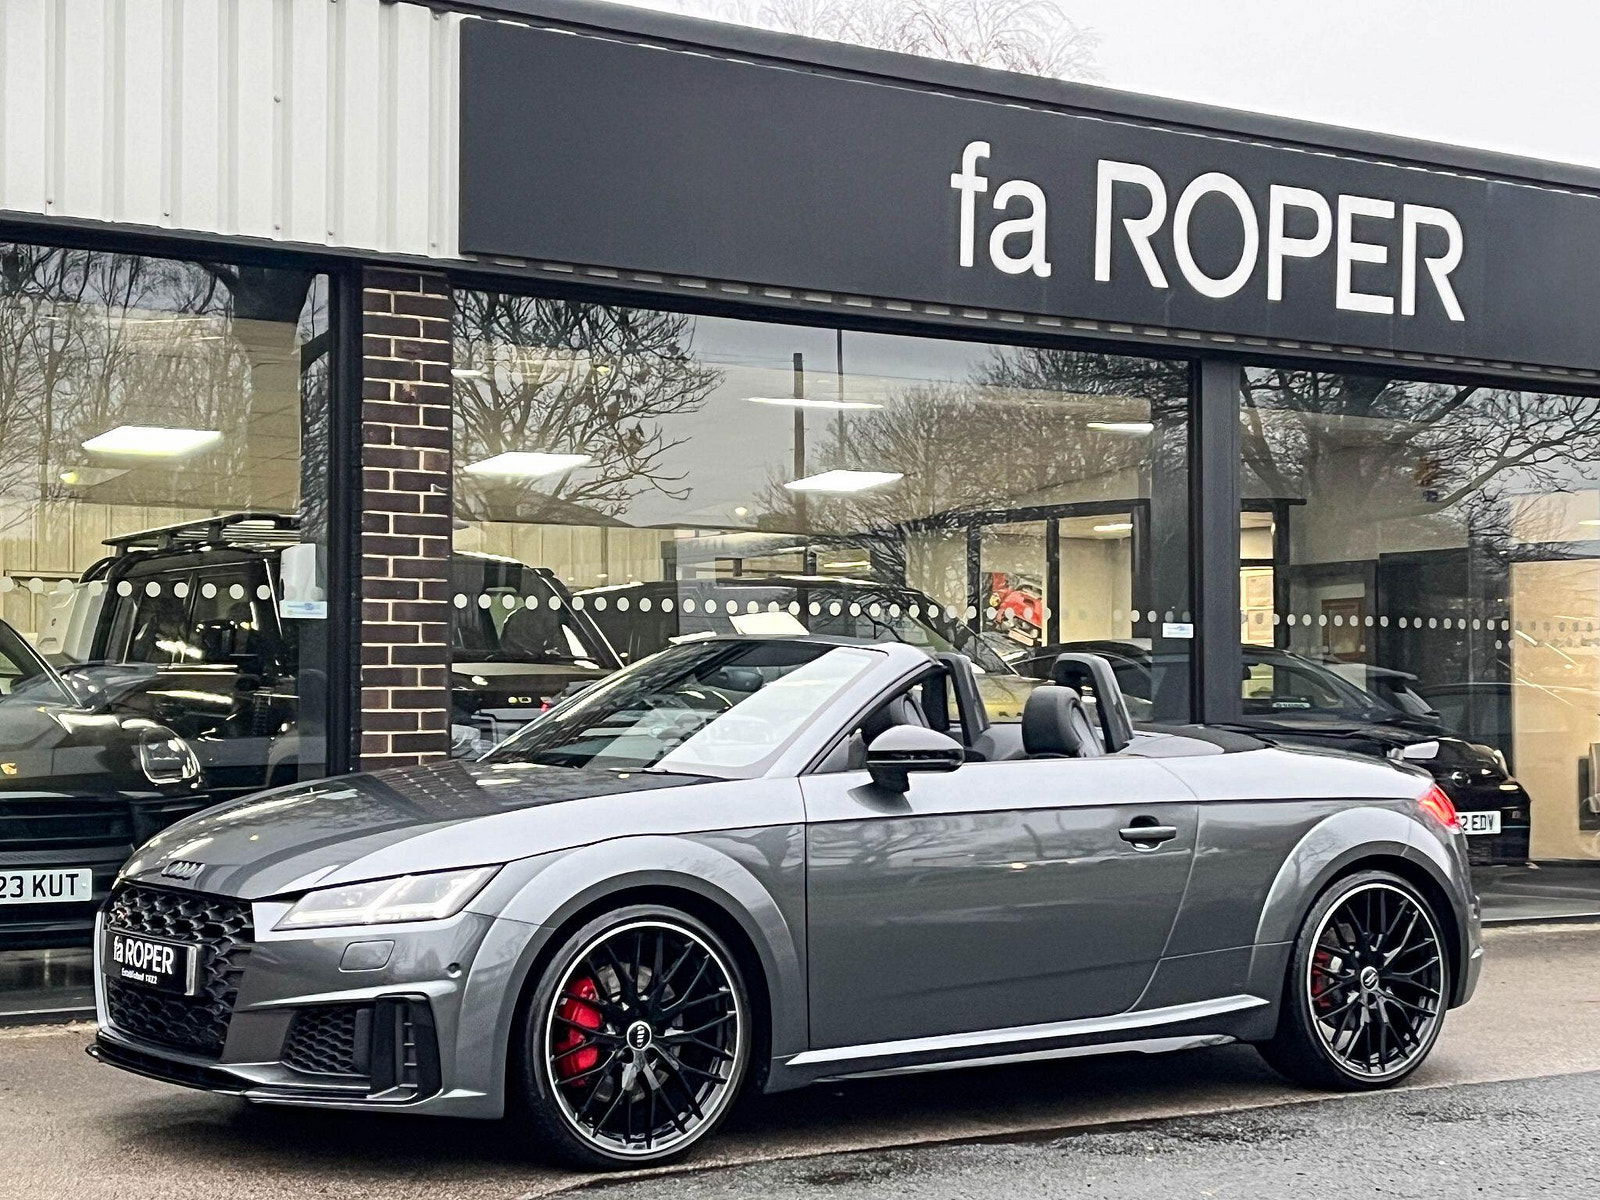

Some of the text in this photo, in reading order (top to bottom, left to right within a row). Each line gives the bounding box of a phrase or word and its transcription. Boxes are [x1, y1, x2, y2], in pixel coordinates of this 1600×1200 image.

[951, 141, 1466, 322] fa ROPER
[32, 873, 79, 898] KUT
[113, 935, 174, 975] fa ROPER
